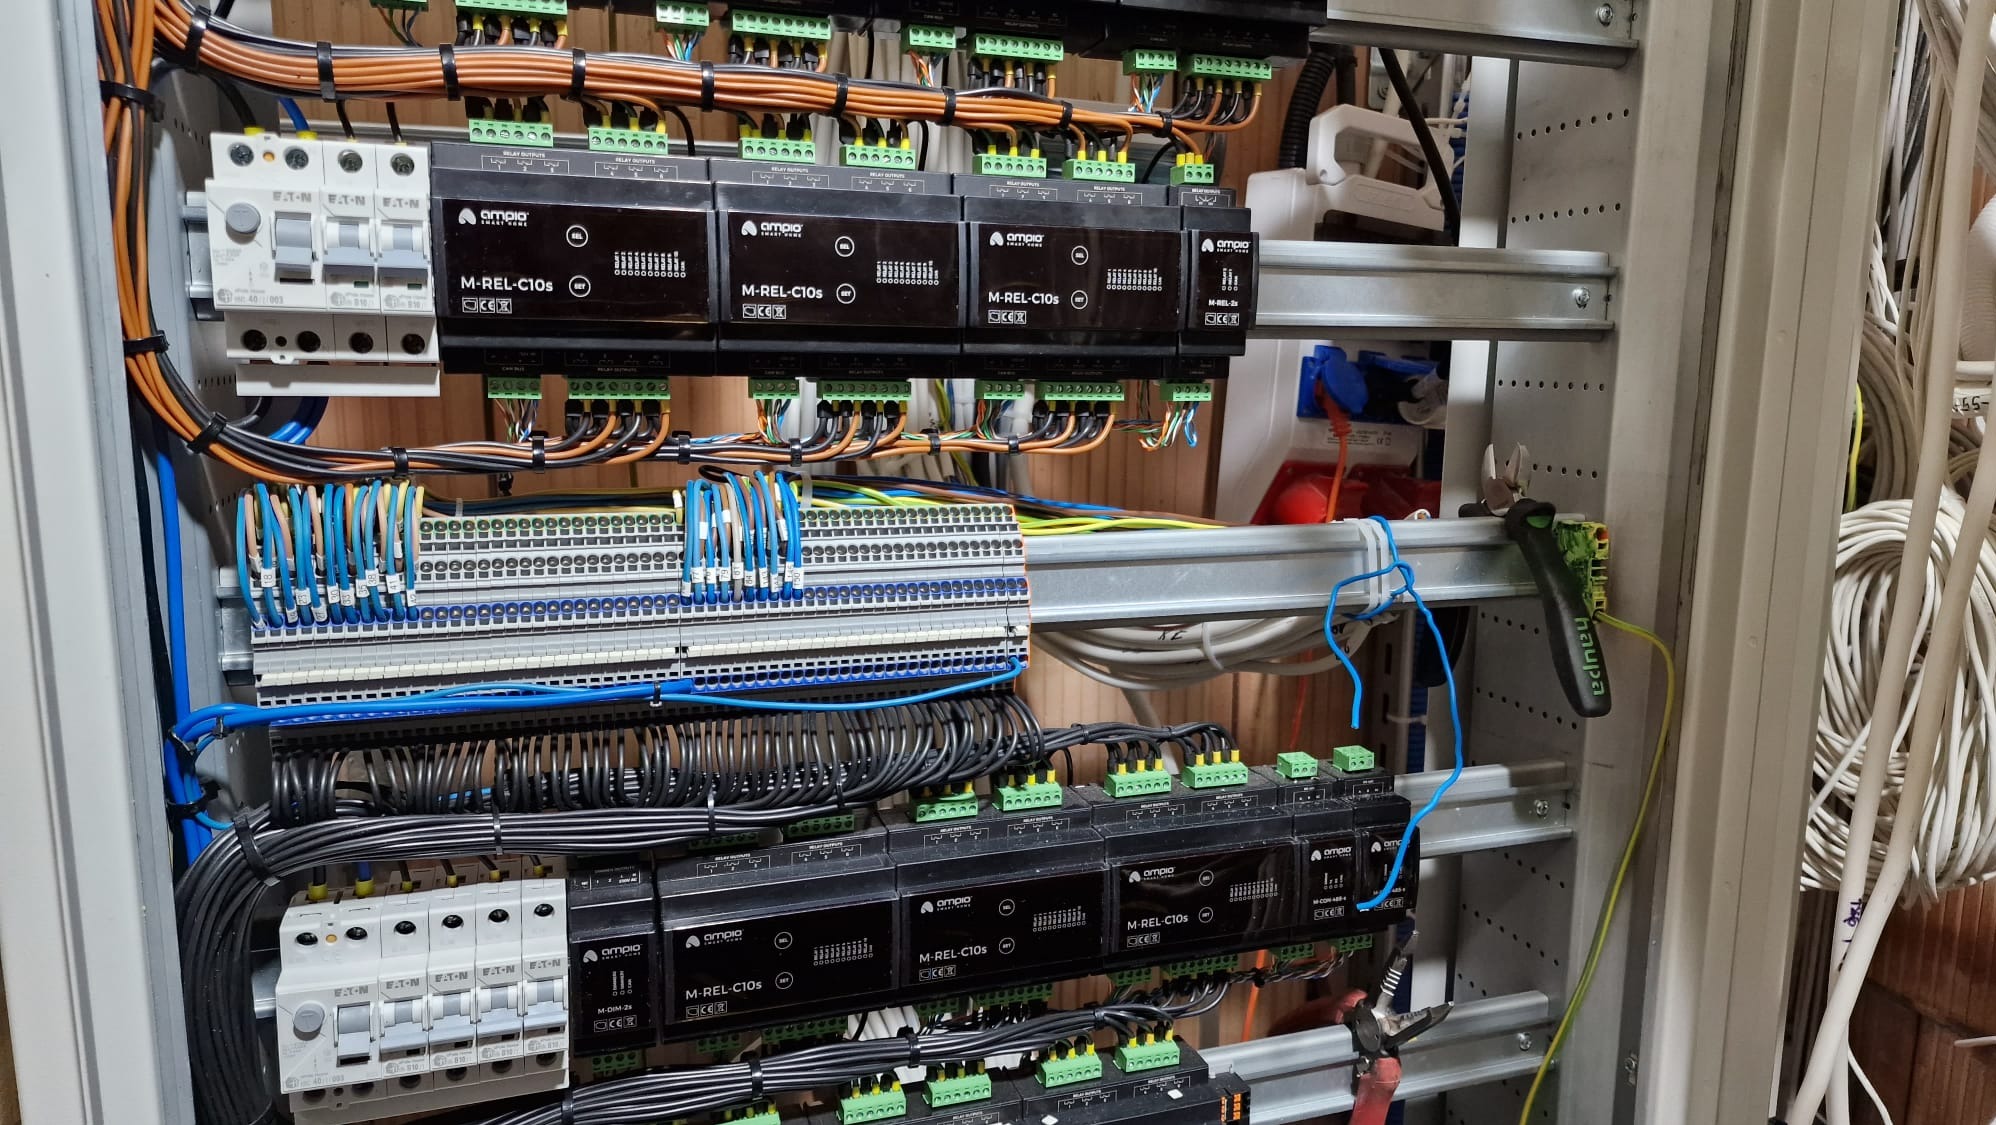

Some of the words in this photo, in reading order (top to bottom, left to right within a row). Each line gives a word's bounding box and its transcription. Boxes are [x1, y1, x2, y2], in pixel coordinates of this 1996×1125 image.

[480, 209, 528, 222] ampio
[761, 222, 802, 234] ampio
[1007, 233, 1043, 244] ampio
[1217, 240, 1249, 250] ampio
[461, 276, 553, 292] M-REL-C10s
[742, 284, 823, 299] M-REL-C10s
[988, 291, 1060, 305] M-REL-C10s
[1208, 299, 1238, 307] M-REL-2s
[263, 575, 272, 583] 18
[388, 580, 397, 590] 41
[1574, 617, 1604, 696] haupa
[1324, 847, 1352, 856] ampio
[1144, 867, 1175, 877] ampio
[937, 896, 971, 907] ampio
[1127, 914, 1189, 930] M-REL-C10s
[704, 930, 743, 941] ampio
[602, 944, 641, 956] ampio
[919, 946, 988, 963] M-REL-C10s
[685, 980, 762, 1000] M-REL-C10s
[597, 1004, 632, 1015] M-DIM-2s
